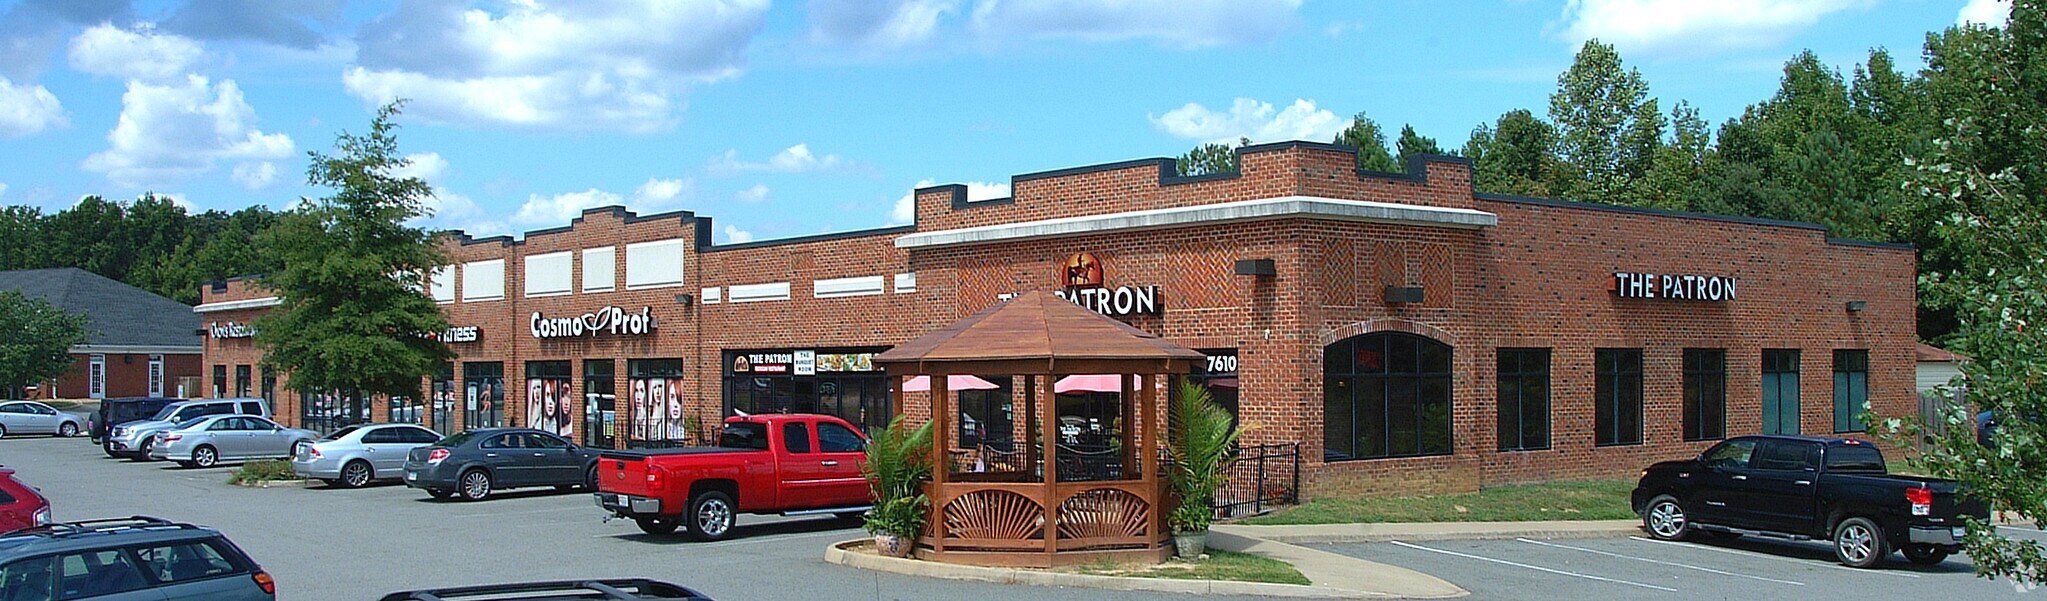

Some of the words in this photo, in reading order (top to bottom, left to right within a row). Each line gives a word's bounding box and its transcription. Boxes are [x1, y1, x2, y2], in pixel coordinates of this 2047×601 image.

[1616, 273, 1654, 298] THE
[1662, 274, 1736, 301] PATRON
[531, 312, 583, 338] Cosmo
[611, 306, 649, 335] Prof
[749, 354, 763, 364] THE
[764, 353, 792, 364] PATRON
[1207, 355, 1237, 372] 7610
